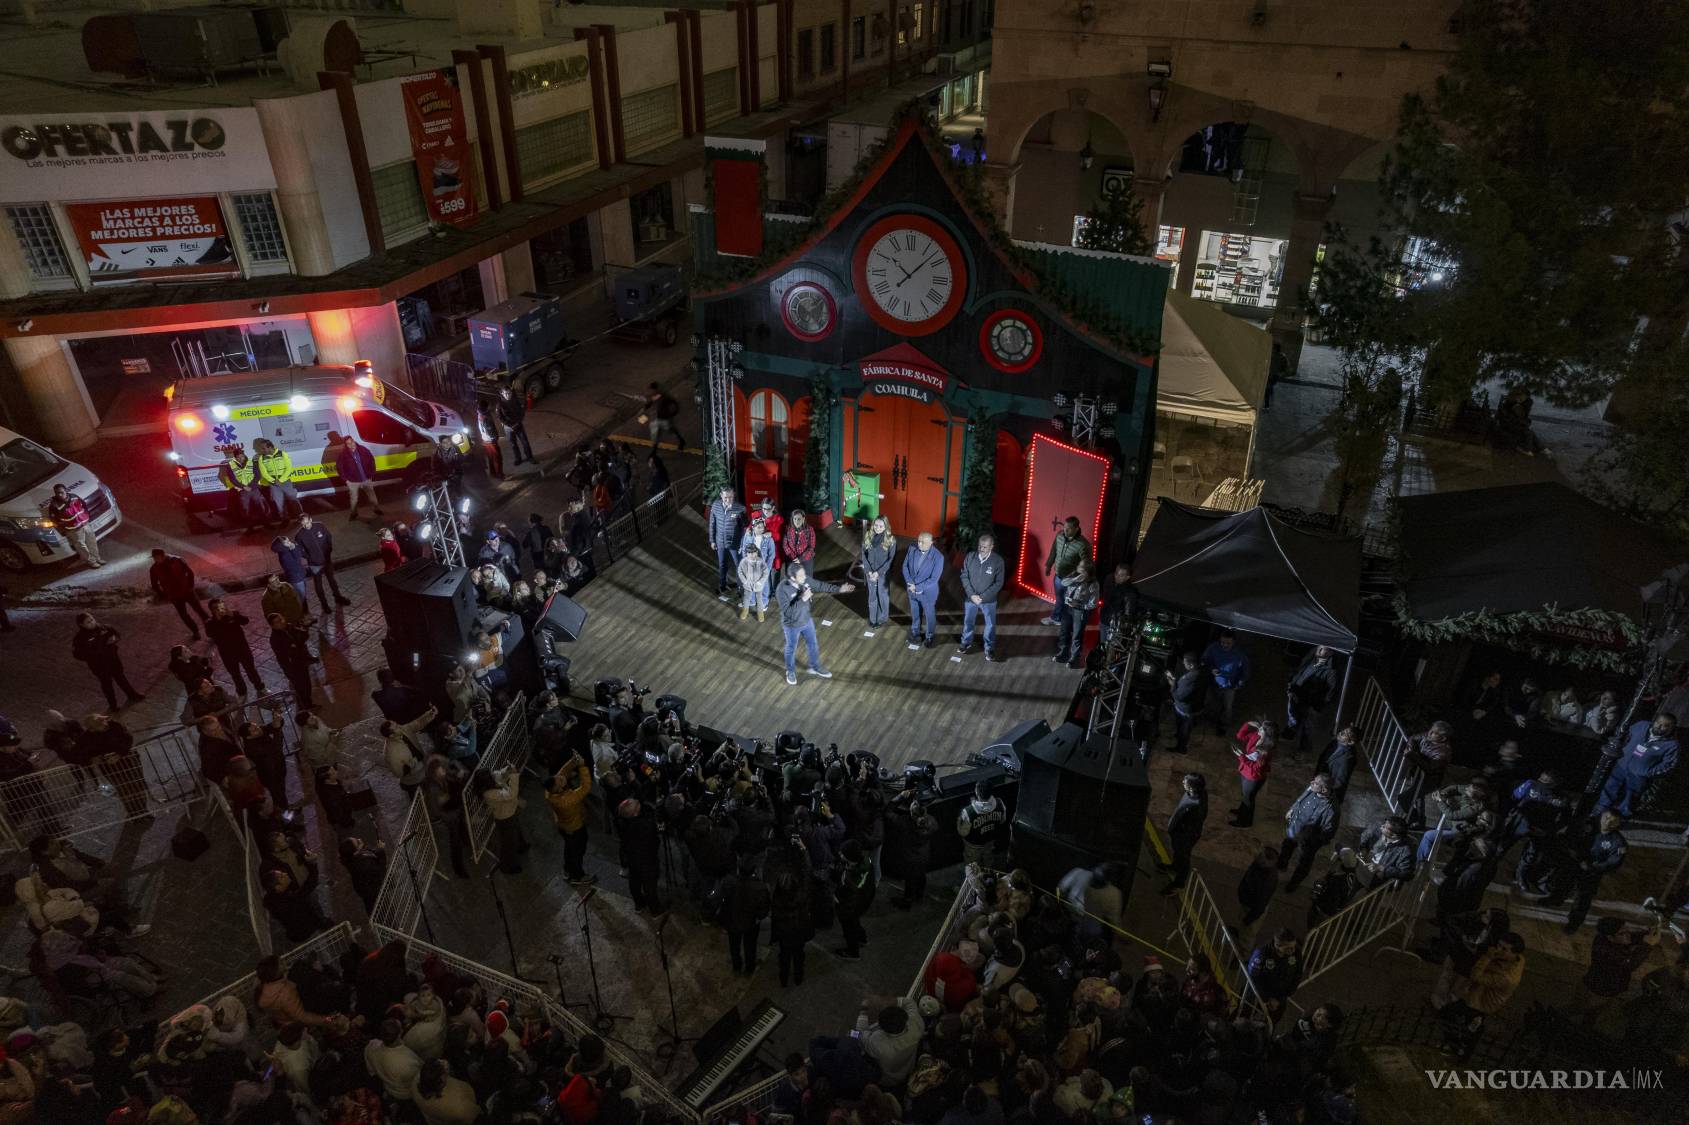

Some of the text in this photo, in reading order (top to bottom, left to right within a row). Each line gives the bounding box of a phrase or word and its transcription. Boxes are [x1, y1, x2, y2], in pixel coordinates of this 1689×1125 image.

[2, 118, 225, 160] OFERTAZO
[27, 159, 44, 168] Las
[46, 157, 86, 168] mejores
[89, 155, 123, 164] marcas
[134, 152, 149, 162] los
[151, 151, 189, 162] mejores
[192, 150, 226, 160] precios
[134, 205, 195, 217] MEJORES
[103, 214, 200, 229] MARCAS A LOS
[91, 223, 216, 240] MEJORES PRECIOS!
[147, 245, 168, 253] VANS
[863, 364, 943, 389] FÁBRICA DE SANTA
[875, 384, 927, 402] COAHUILA
[214, 443, 244, 452] SAMU
